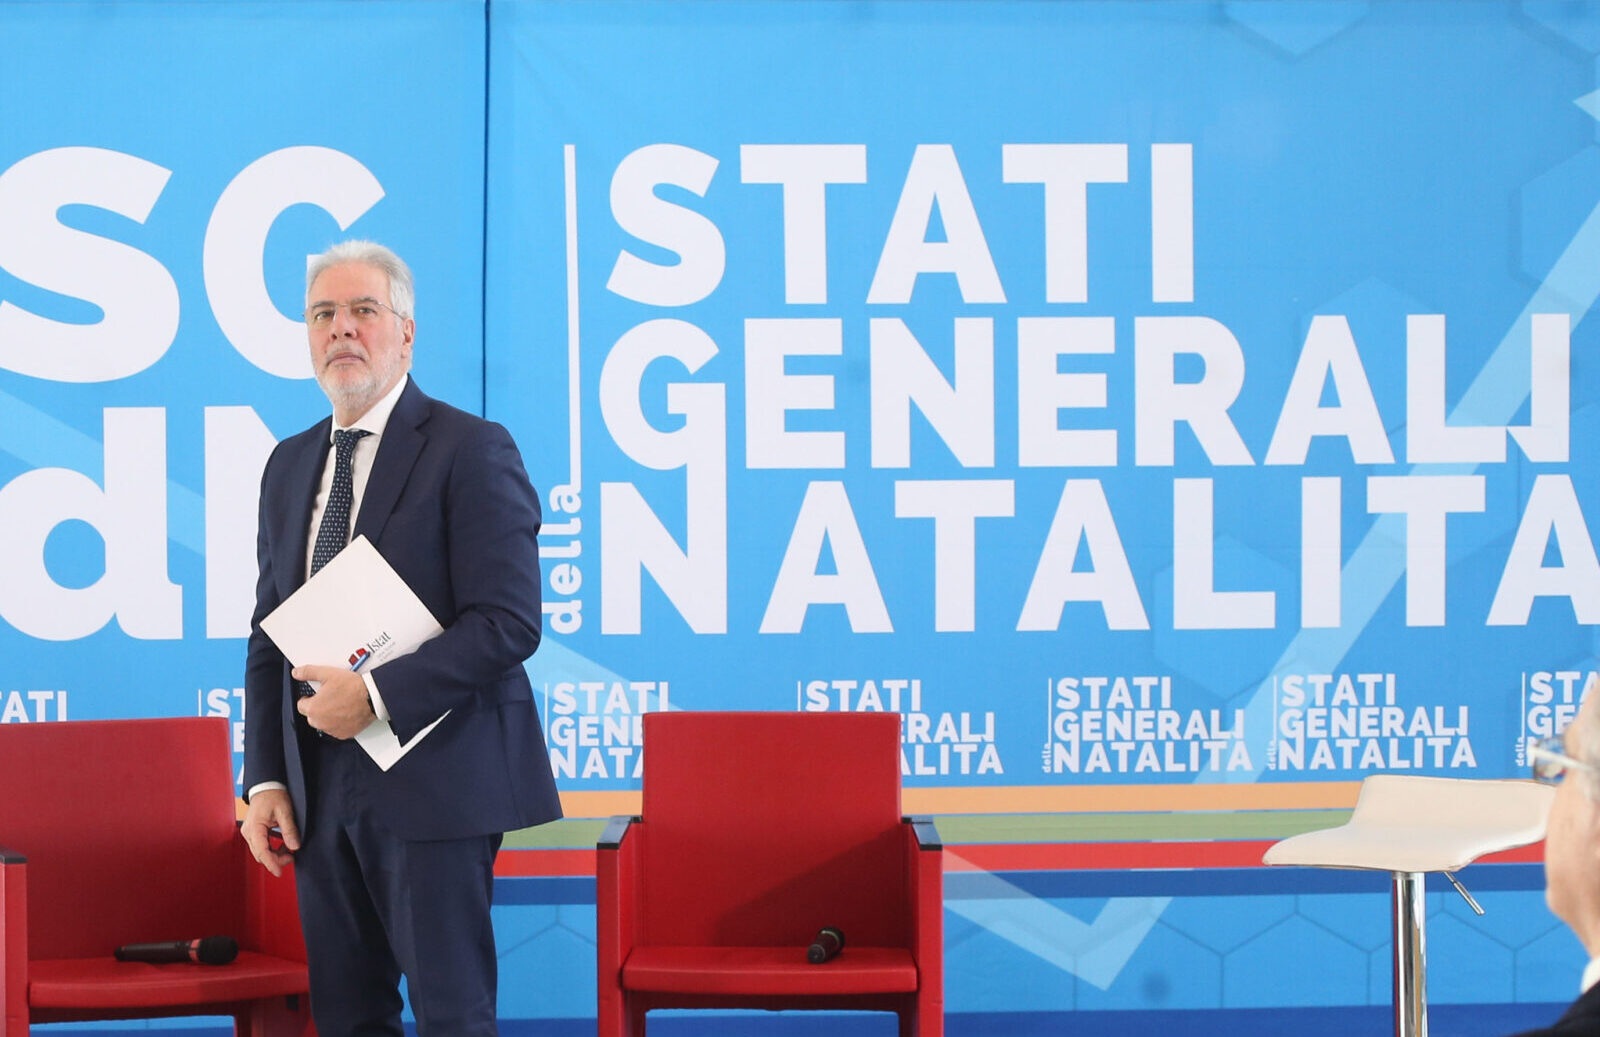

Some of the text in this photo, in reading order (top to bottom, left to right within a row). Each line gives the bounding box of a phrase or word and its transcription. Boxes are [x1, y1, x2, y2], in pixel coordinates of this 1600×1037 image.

[605, 142, 1194, 307] STATI
[0, 145, 386, 384] SG
[598, 313, 1571, 471] GENERALI
[539, 484, 583, 635] della
[599, 474, 1600, 635] NATALITA
[366, 631, 391, 654] Istat
[552, 681, 669, 716] STATI
[805, 679, 921, 712] STATI
[1056, 676, 1171, 710] STATI
[1281, 673, 1396, 707] STATI
[0, 691, 67, 724] ATI
[1279, 706, 1469, 739] GENERALI
[1527, 704, 1583, 738] GE
[900, 711, 995, 744] RALI
[1054, 709, 1244, 742] GENERALI
[1041, 742, 1052, 774] della
[1053, 740, 1254, 774] NATALITA
[1278, 737, 1478, 771] NATALITA
